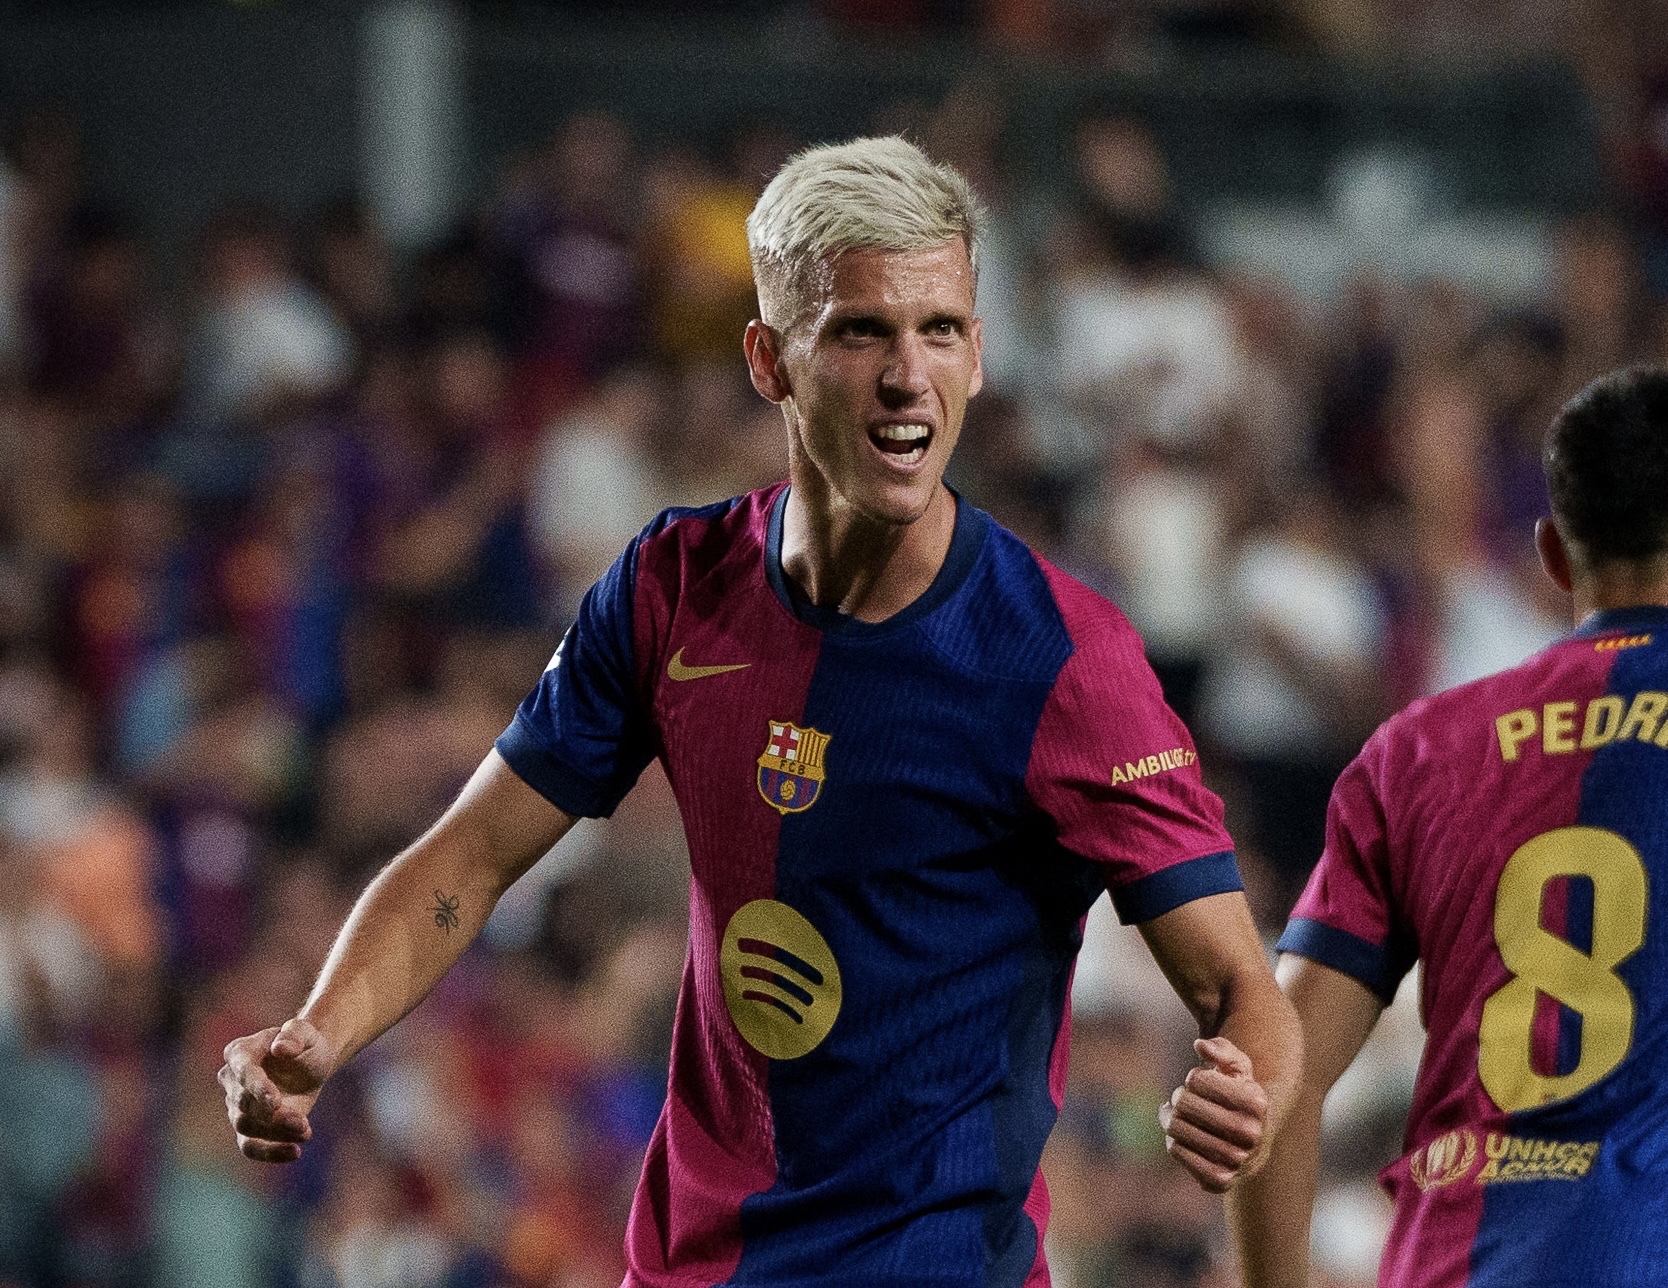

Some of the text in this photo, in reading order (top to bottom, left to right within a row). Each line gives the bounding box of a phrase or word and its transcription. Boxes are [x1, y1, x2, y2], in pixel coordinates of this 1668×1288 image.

[1495, 690, 1668, 763] PEDR
[780, 760, 806, 775] FCB
[1477, 826, 1649, 1114] 8
